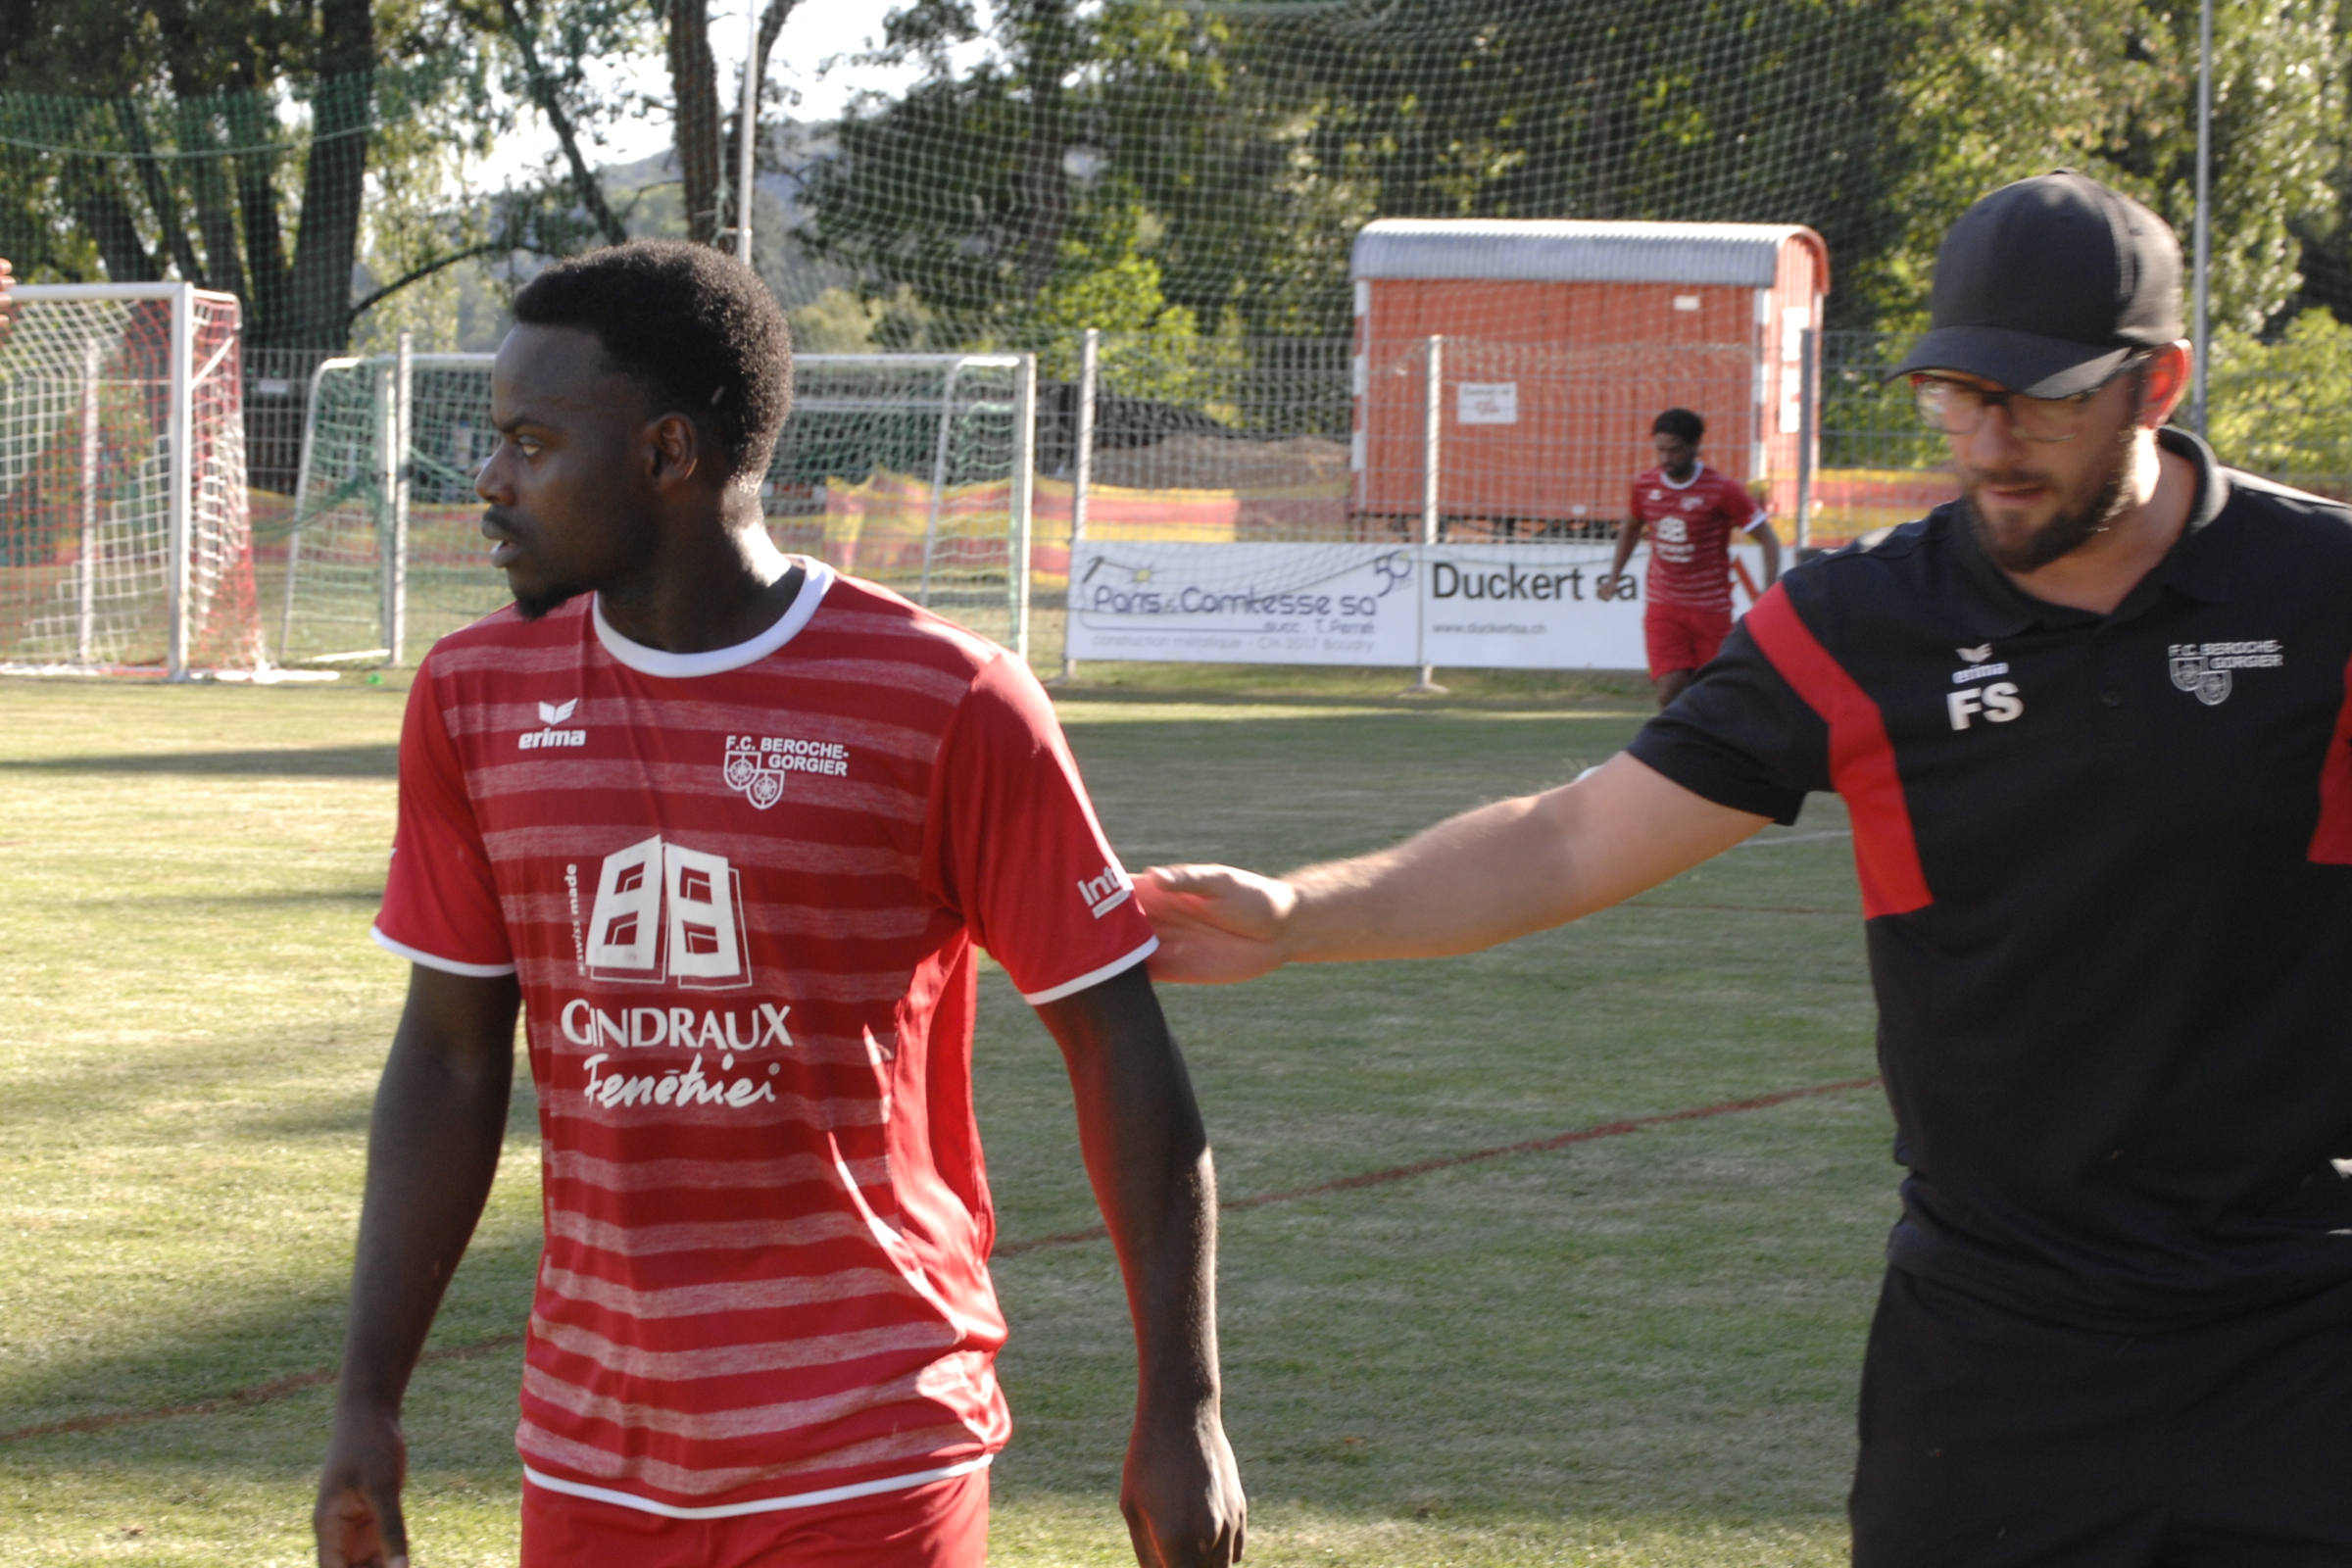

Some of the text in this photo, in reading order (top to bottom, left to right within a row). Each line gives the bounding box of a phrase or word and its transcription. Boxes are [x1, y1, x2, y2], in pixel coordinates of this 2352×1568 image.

[1433, 563, 1585, 600] Duckert
[1946, 681, 2024, 731] FS
[517, 727, 587, 750] erima
[725, 735, 850, 760] F.C. BEROCHE-
[768, 754, 849, 777] GORGIER
[561, 998, 794, 1051] GINDRAUX
